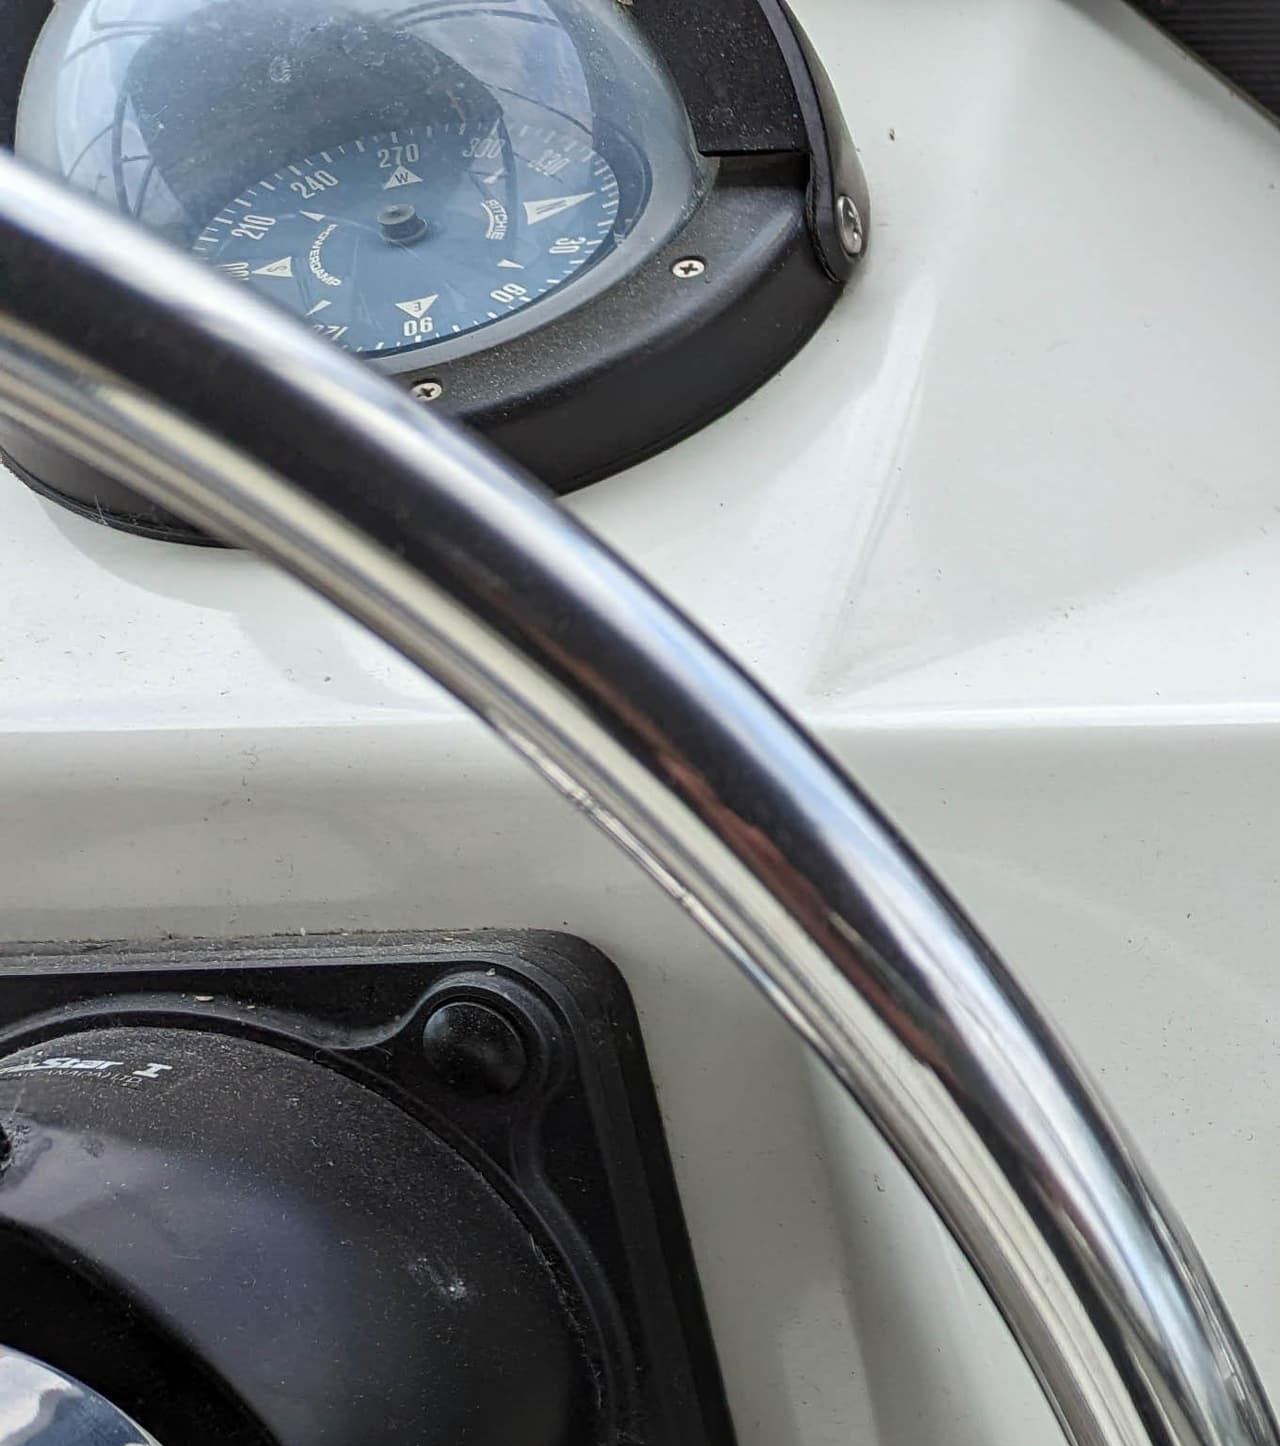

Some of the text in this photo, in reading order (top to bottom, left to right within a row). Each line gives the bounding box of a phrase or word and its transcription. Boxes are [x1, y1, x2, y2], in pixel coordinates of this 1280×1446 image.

[377, 143, 420, 169] 270
[290, 170, 339, 200] 240
[231, 215, 276, 241] 210
[309, 224, 342, 287] POWERDAMP
[549, 236, 586, 254] 30
[490, 282, 527, 303] 60
[403, 316, 433, 337] 90
